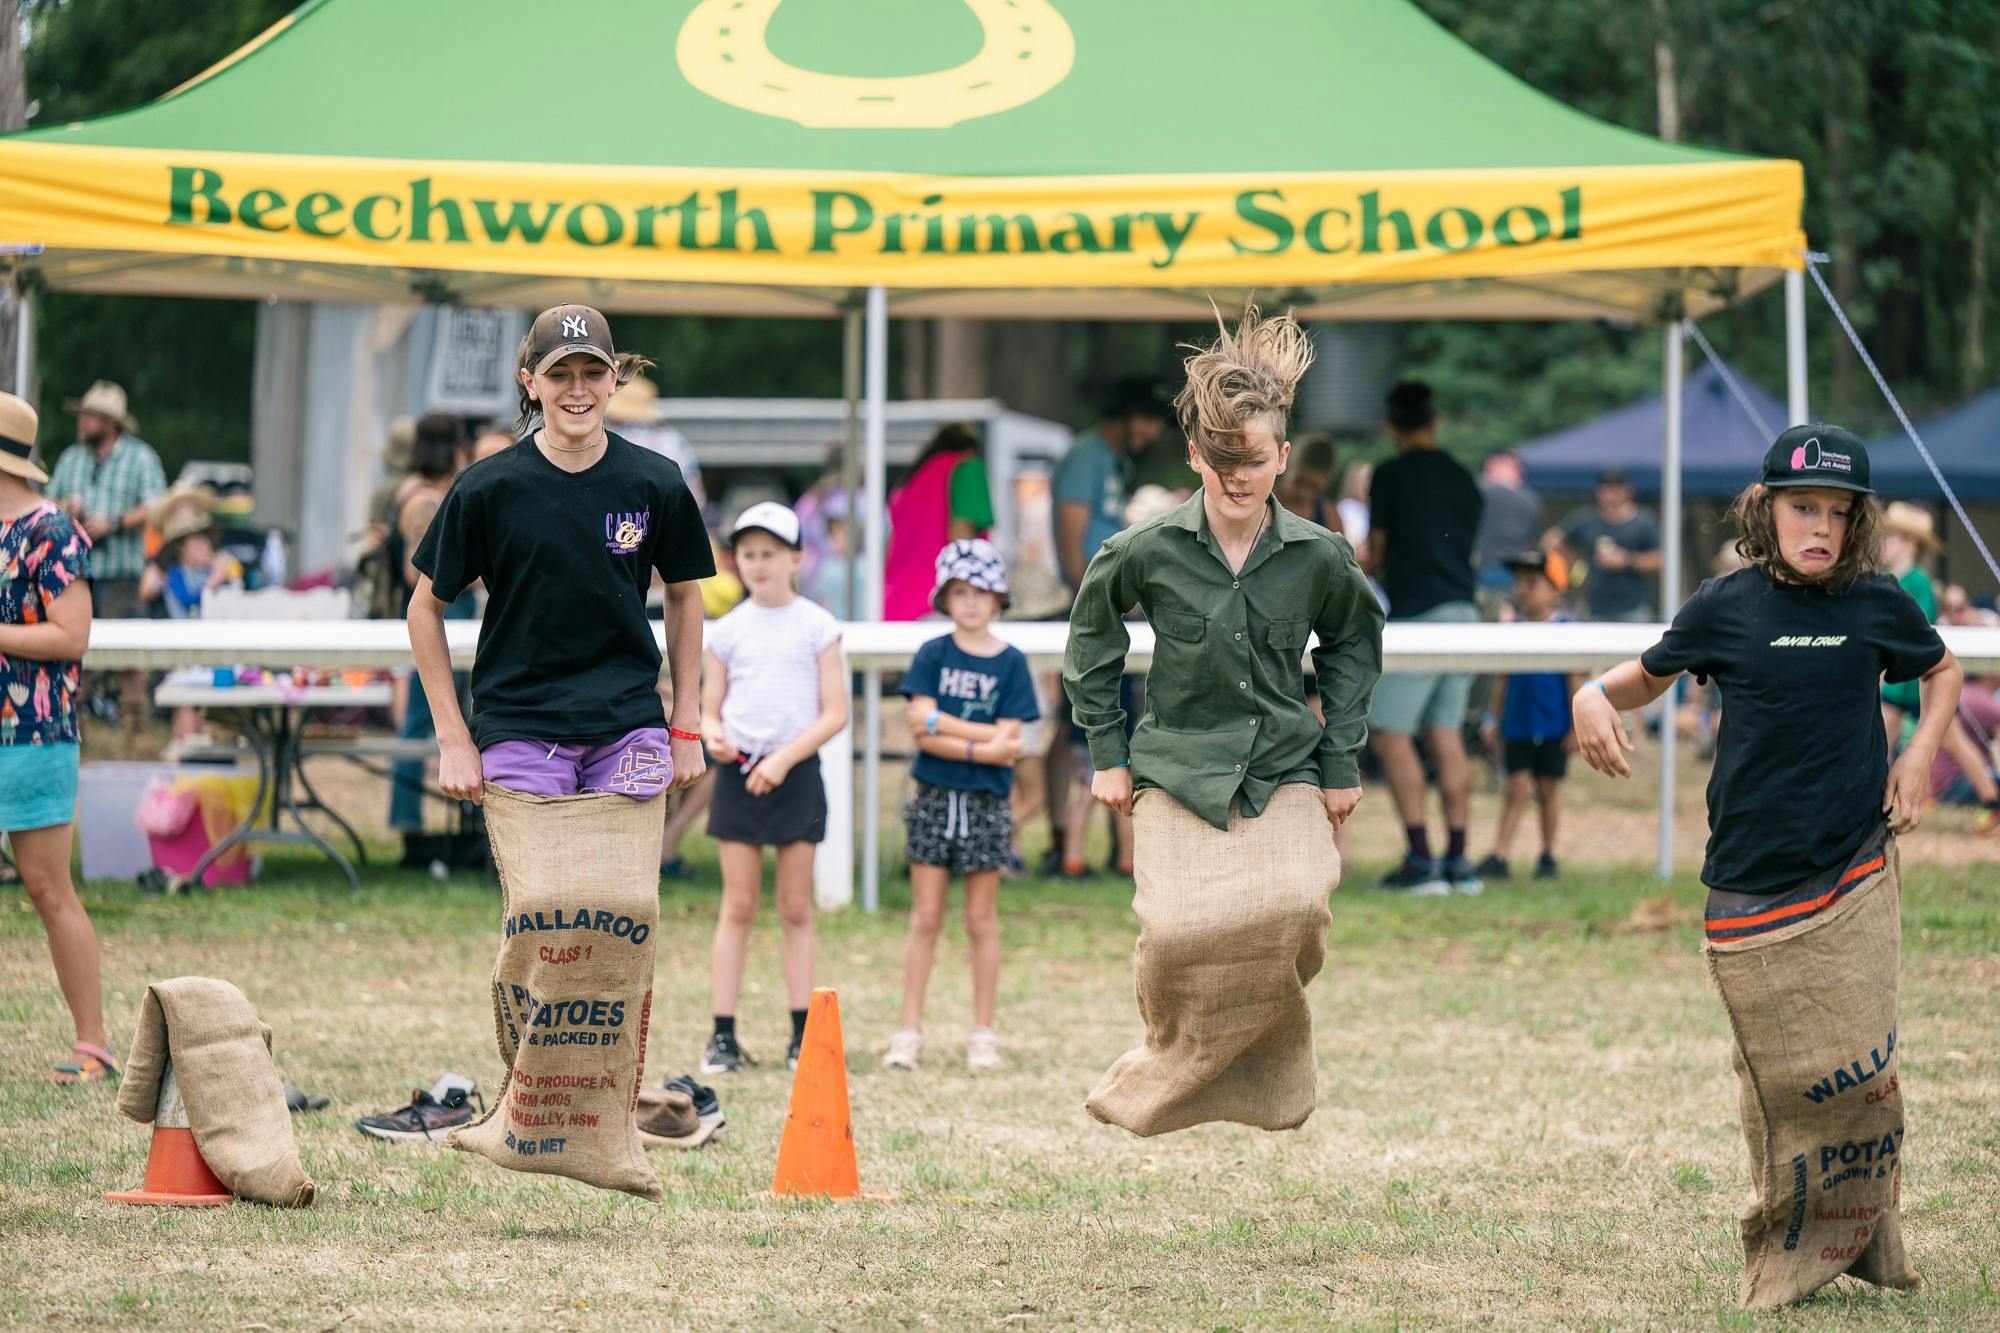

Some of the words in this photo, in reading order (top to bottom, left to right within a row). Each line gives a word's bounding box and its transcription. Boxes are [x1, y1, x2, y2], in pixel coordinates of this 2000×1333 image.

[166, 165, 780, 253] Beechworth
[808, 189, 1200, 269] Primary
[1228, 185, 1583, 255] School
[561, 314, 589, 338] NY
[1832, 461, 1852, 472] Award
[1769, 635, 1813, 647] SANTA
[1811, 635, 1848, 647] CRUZ
[939, 666, 998, 702] HEY
[506, 908, 650, 946] WALLAROO
[539, 944, 581, 965] CLASS
[583, 944, 593, 960] 1
[511, 983, 625, 1028] PATOES
[529, 1032, 539, 1046] &
[543, 1032, 598, 1047] PACKED
[600, 1032, 621, 1046] BY
[1803, 1018, 1898, 1105] WALLA
[536, 1074, 597, 1090] PRODUCE
[1865, 1071, 1899, 1105] CLAS
[540, 1093, 572, 1107] 4005
[569, 1113, 600, 1128] NSW
[517, 1139, 537, 1156] KG
[540, 1137, 567, 1154] NET
[1822, 1165, 1873, 1191] GROWN
[1876, 1166, 1887, 1180] &
[1854, 1225, 1872, 1240] FA
[1820, 1245, 1863, 1262] COLE
